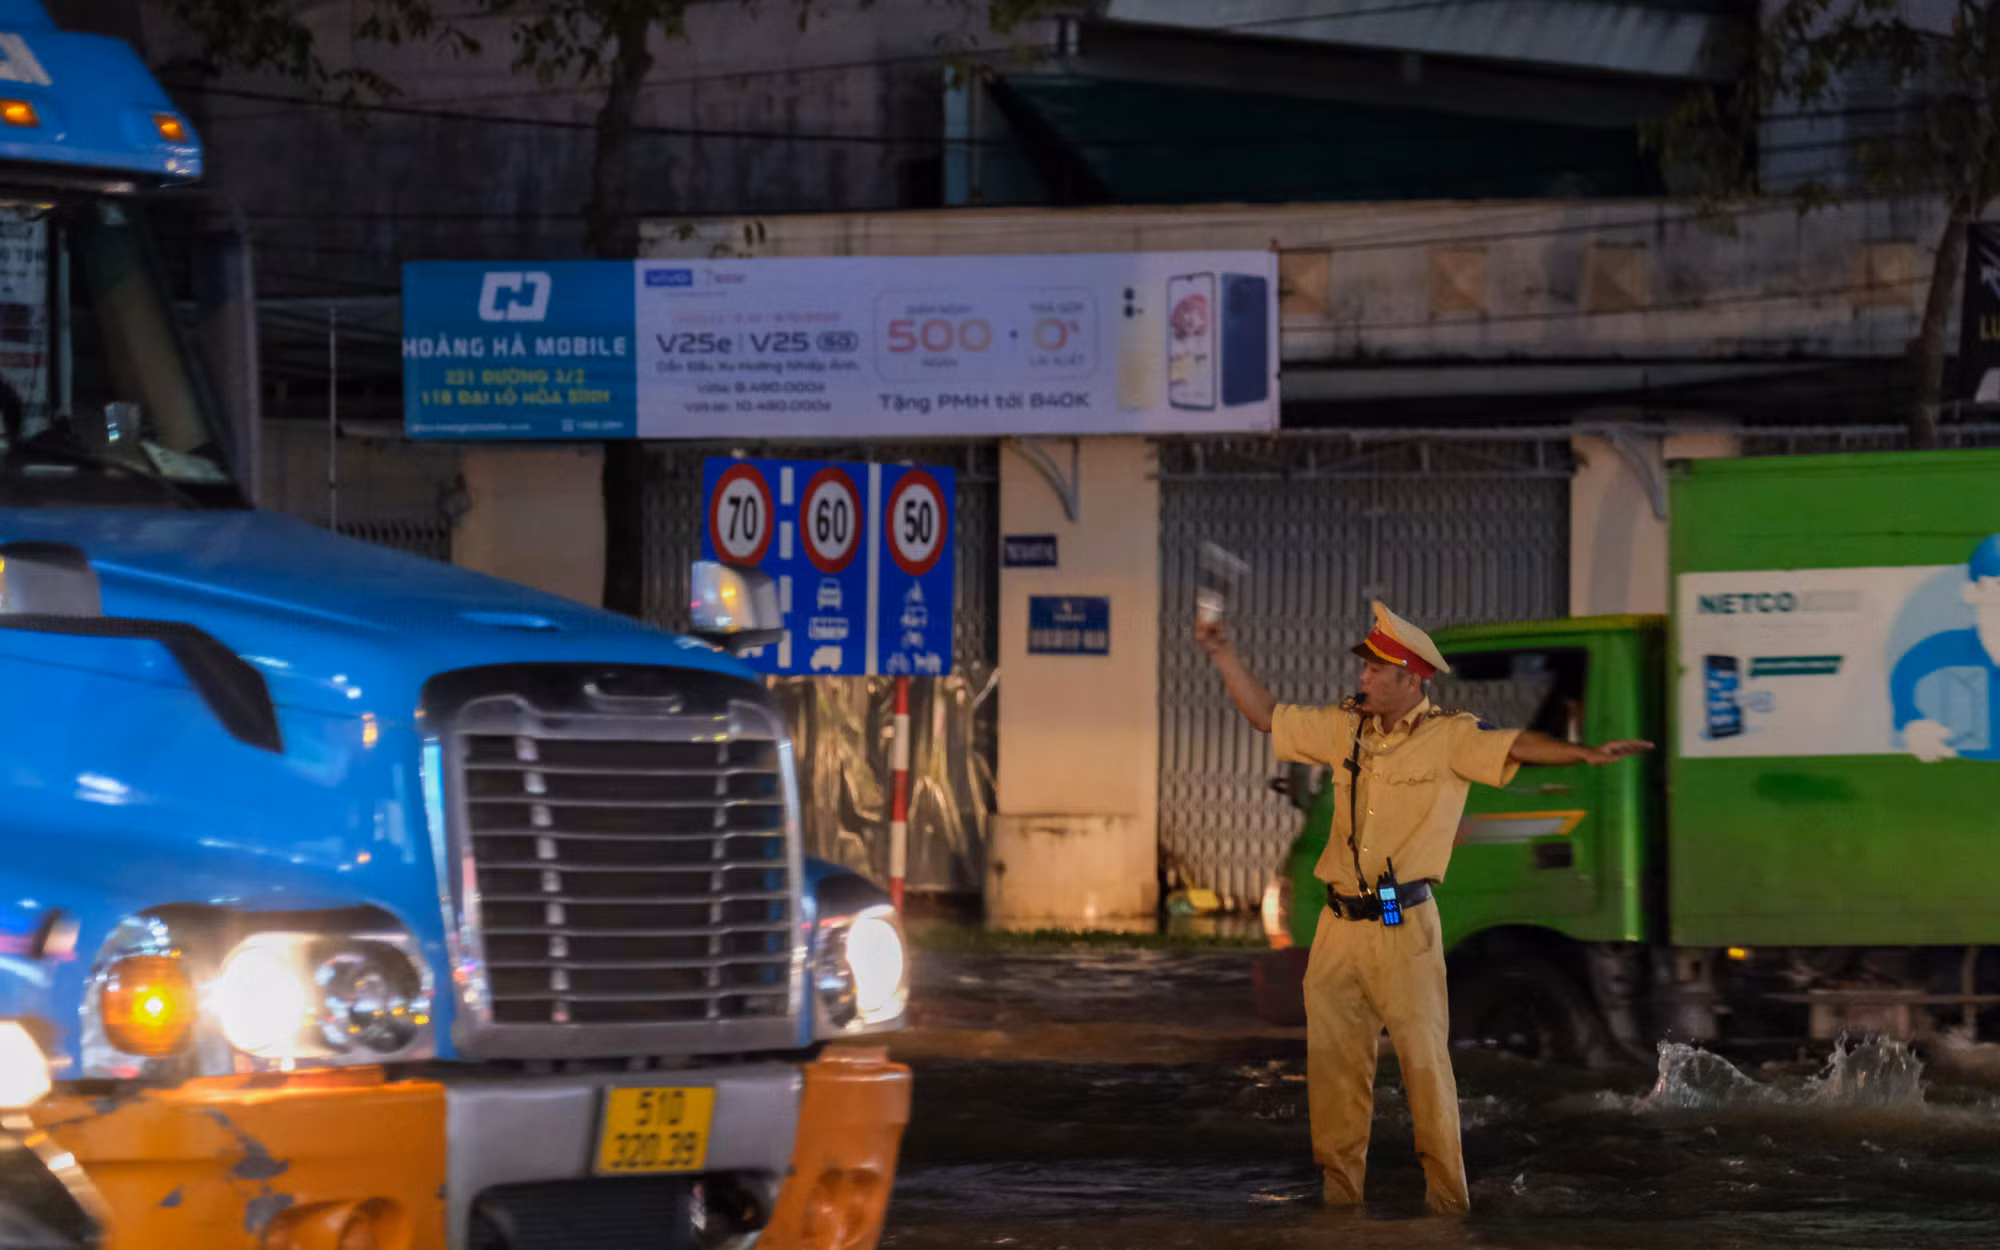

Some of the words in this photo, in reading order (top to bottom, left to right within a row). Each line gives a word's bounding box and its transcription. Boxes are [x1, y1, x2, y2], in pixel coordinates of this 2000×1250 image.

[402, 331, 484, 358] HOÀNG
[493, 331, 526, 358] HÀ
[535, 336, 626, 357] MOBILE
[656, 332, 732, 353] V25e
[750, 332, 809, 353] V25
[888, 319, 992, 352] 500
[879, 393, 931, 415] Tặng
[938, 393, 989, 409] PMH
[995, 391, 1023, 410] tới
[727, 496, 758, 541] 70
[816, 498, 848, 544] 60
[904, 500, 932, 543] 50
[1698, 591, 1796, 614] NETCO
